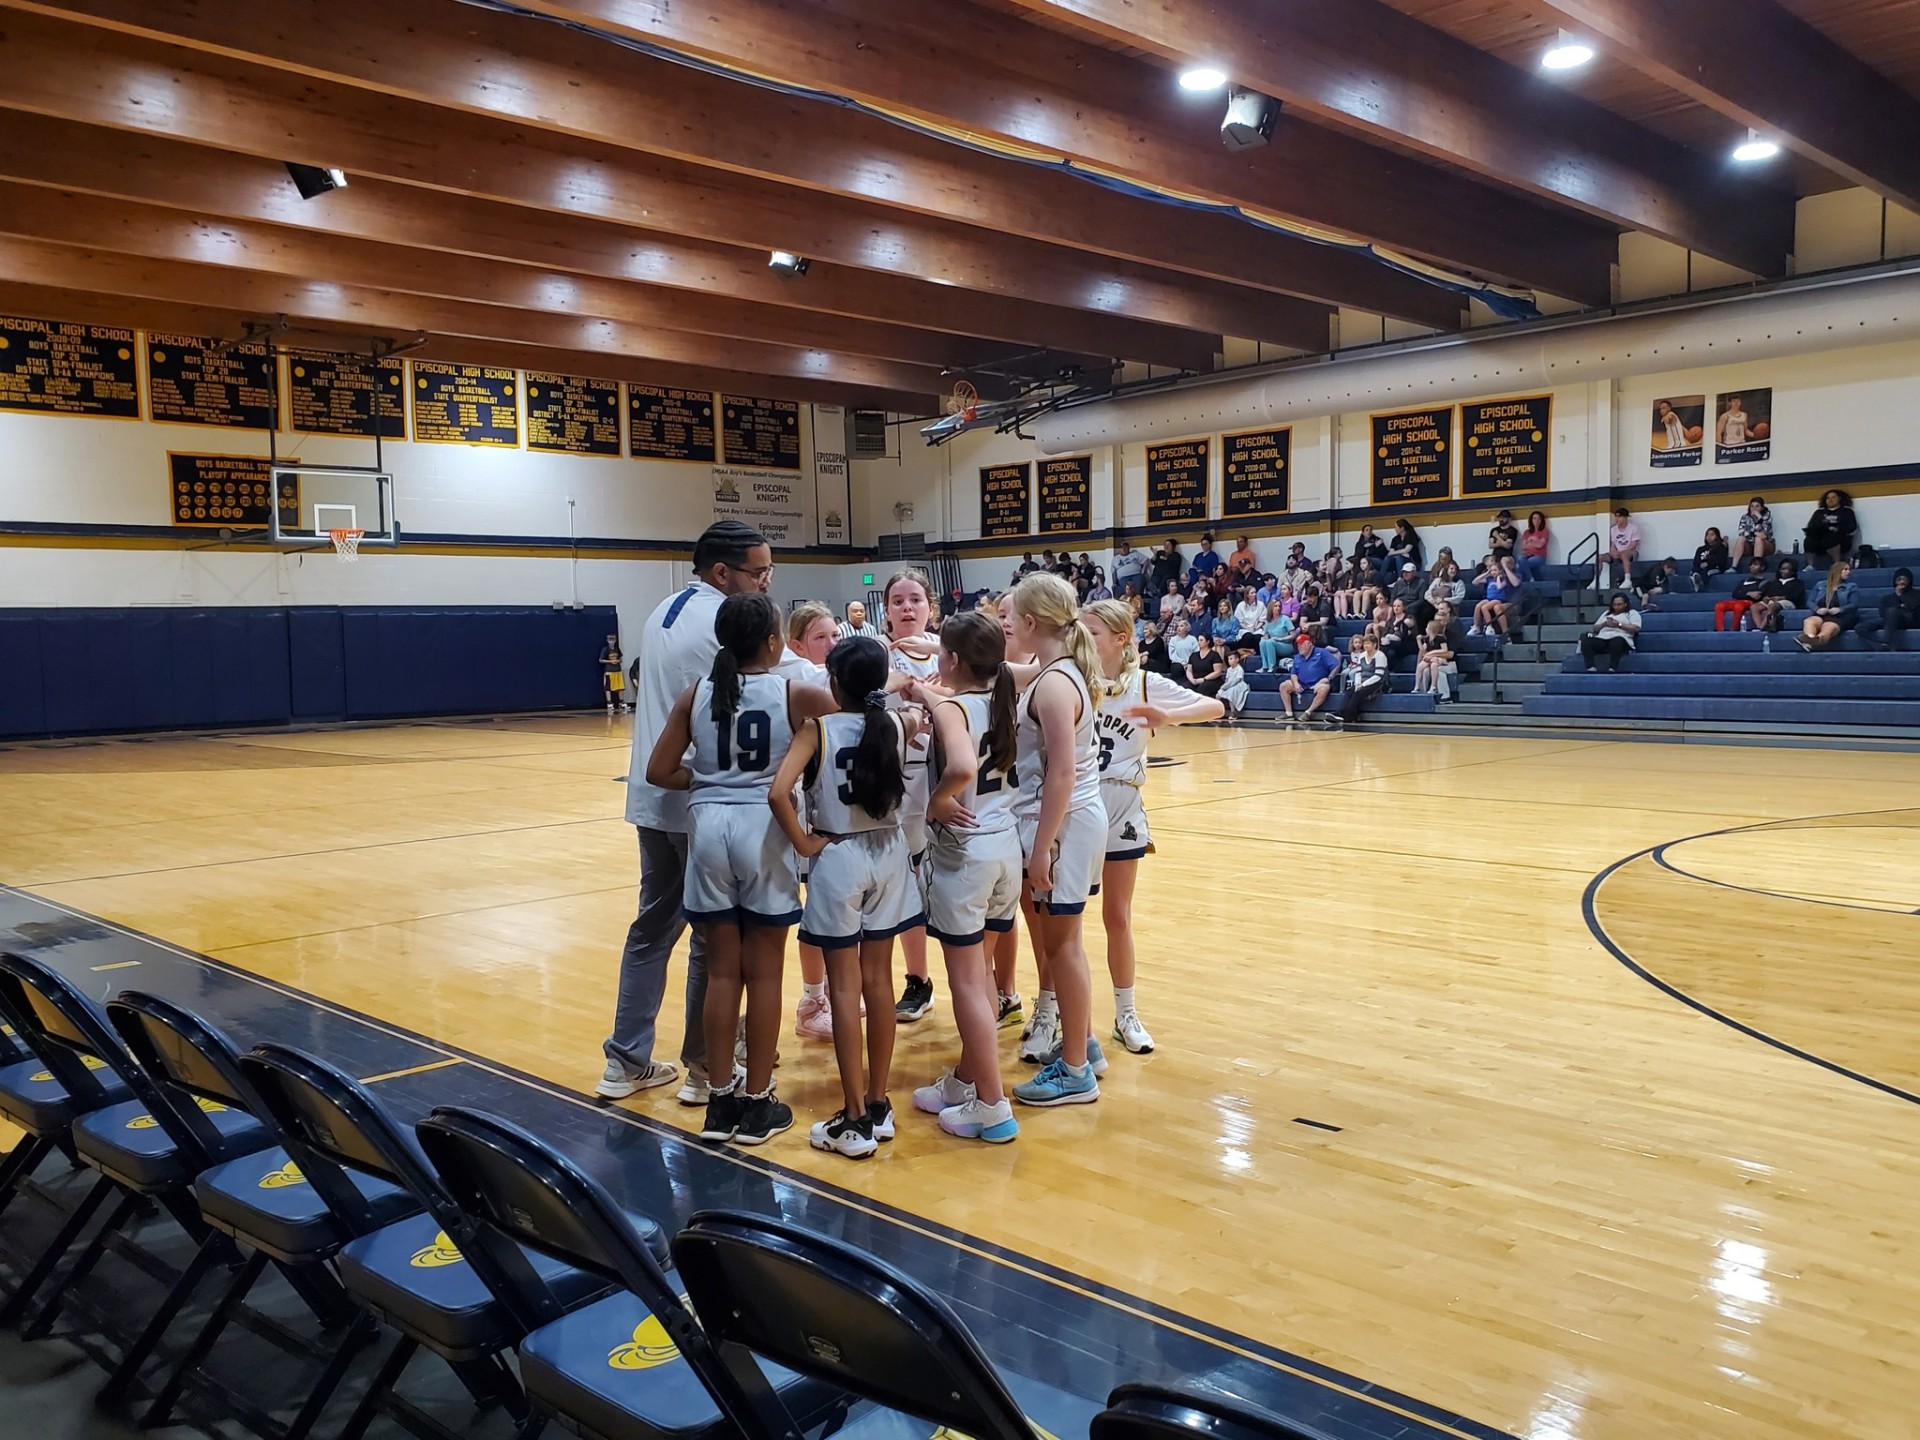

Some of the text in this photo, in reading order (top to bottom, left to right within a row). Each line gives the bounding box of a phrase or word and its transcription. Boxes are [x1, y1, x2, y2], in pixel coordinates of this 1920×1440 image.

[60, 323, 85, 336] HIGH
[91, 328, 134, 342] SCHOOL
[148, 333, 206, 349] EPISCOPAL
[29, 340, 99, 355] BOYS BASKETBALL
[50, 351, 65, 360] TOP
[26, 357, 103, 371] STATE SEMI-FINALIST
[184, 355, 245, 369] BOYS BASKETBALL
[15, 364, 49, 376] DISTRICT
[75, 369, 115, 380] CHAMPIONS
[202, 365, 215, 373] TOP
[320, 370, 336, 380] BOYS
[415, 362, 459, 376] EPISCOPAL
[462, 366, 481, 378] HIGH
[484, 368, 515, 381] SCHOOL
[181, 371, 248, 385] STATE SEMI-FINALIST
[312, 378, 329, 387] STATE
[527, 372, 618, 391] EPISCOPAL HIGH SCHOOL
[440, 384, 491, 395] BOYS BASKETBALL
[630, 384, 712, 402] EPISCOPAL HIGH SCHOOL
[433, 392, 498, 404] STATE QUARTERFINALIST
[550, 391, 596, 402] BOYS BASKETBALL
[548, 404, 562, 412] STATE
[723, 395, 798, 412] EPISCOPAL HIGH SCHOOL
[533, 410, 554, 418] DISTRICT
[573, 414, 599, 423] CHAMPIONS
[1480, 404, 1531, 419] EPISCOPAL
[1388, 416, 1436, 430] EPISCOPAL
[1474, 418, 1537, 434] HIGH SCHOOL
[1236, 436, 1276, 448] EPISCOPAL
[1383, 429, 1441, 445] HIGH SCHOOL
[1492, 436, 1518, 446] 2014-15
[1159, 446, 1196, 458] EPISCOPAL
[1231, 448, 1281, 462] HIGH SCHOOL
[1476, 445, 1534, 457] BOYS BASKETBALL
[1721, 445, 1767, 456] Parker Rozas
[816, 452, 845, 464] EPISCOPAL
[1385, 454, 1438, 467] BOYS BASKETBALL
[195, 459, 272, 471] BOYS BASKETBALL STAT
[819, 463, 844, 475] KNIGHTS
[1047, 461, 1080, 472] EPISCOPAL
[1155, 458, 1200, 471] HIGH SCHOOL
[1472, 464, 1536, 476] DISTRICT CHAMPIONS
[199, 470, 227, 479] PLAYOFF
[989, 469, 1021, 479] EPISCOPAL
[1044, 472, 1084, 485] HIGH SCHOOL
[1233, 471, 1278, 482] BOYS BASKETBALL
[1382, 474, 1441, 486] DISTRICT CHAMPIONS
[753, 483, 791, 494] EPISCOPAL
[986, 480, 1024, 491] HIGH SCHOOL
[1170, 480, 1198, 489] BASKETBALL
[1496, 479, 1512, 488] 31-3
[757, 494, 789, 503] KNIGHTS
[1231, 488, 1280, 499] DISTRICT CHAMPIONS
[1167, 497, 1192, 506] CHAMPIONS
[759, 522, 789, 532] Episcopal
[763, 531, 786, 541] Knights
[826, 531, 842, 539] 2017
[716, 711, 770, 777] 19
